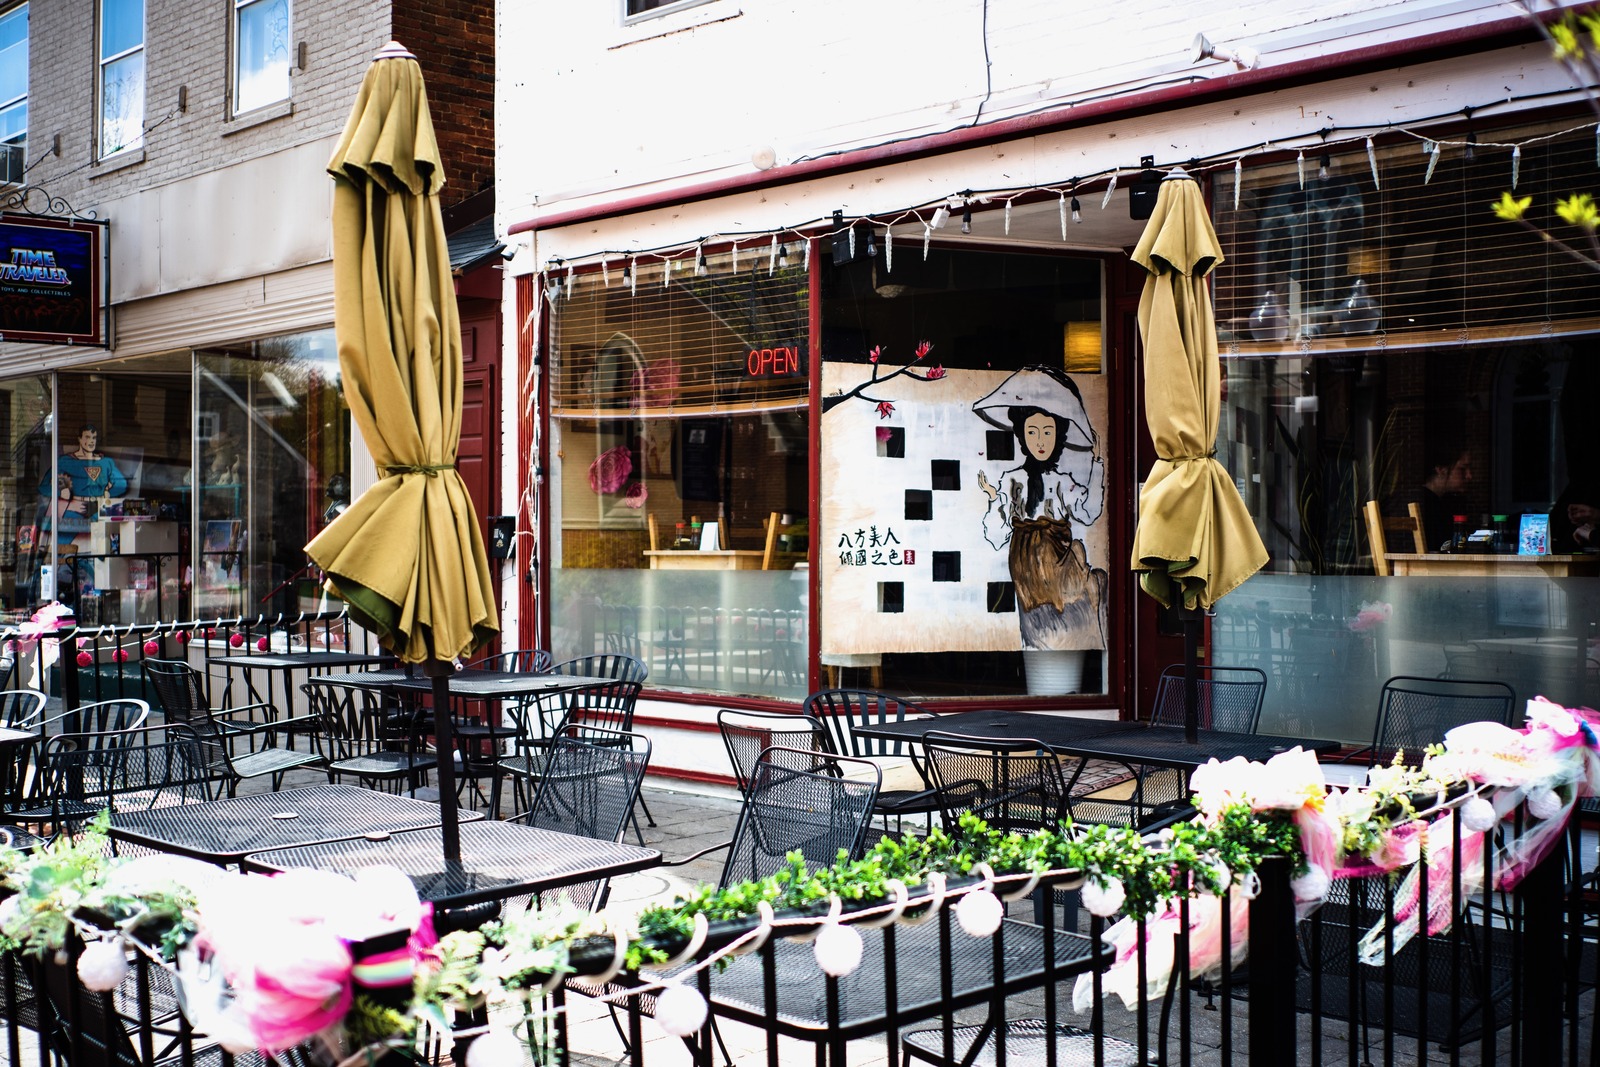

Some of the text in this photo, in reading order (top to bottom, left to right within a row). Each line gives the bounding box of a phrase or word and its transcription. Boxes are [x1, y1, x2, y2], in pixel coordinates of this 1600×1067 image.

[11, 249, 57, 267] TIME
[0, 263, 72, 285] TRAVELER
[30, 288, 71, 297] COLLECTIBLES
[748, 346, 798, 376] OPEN
[838, 525, 900, 548] 八方美人
